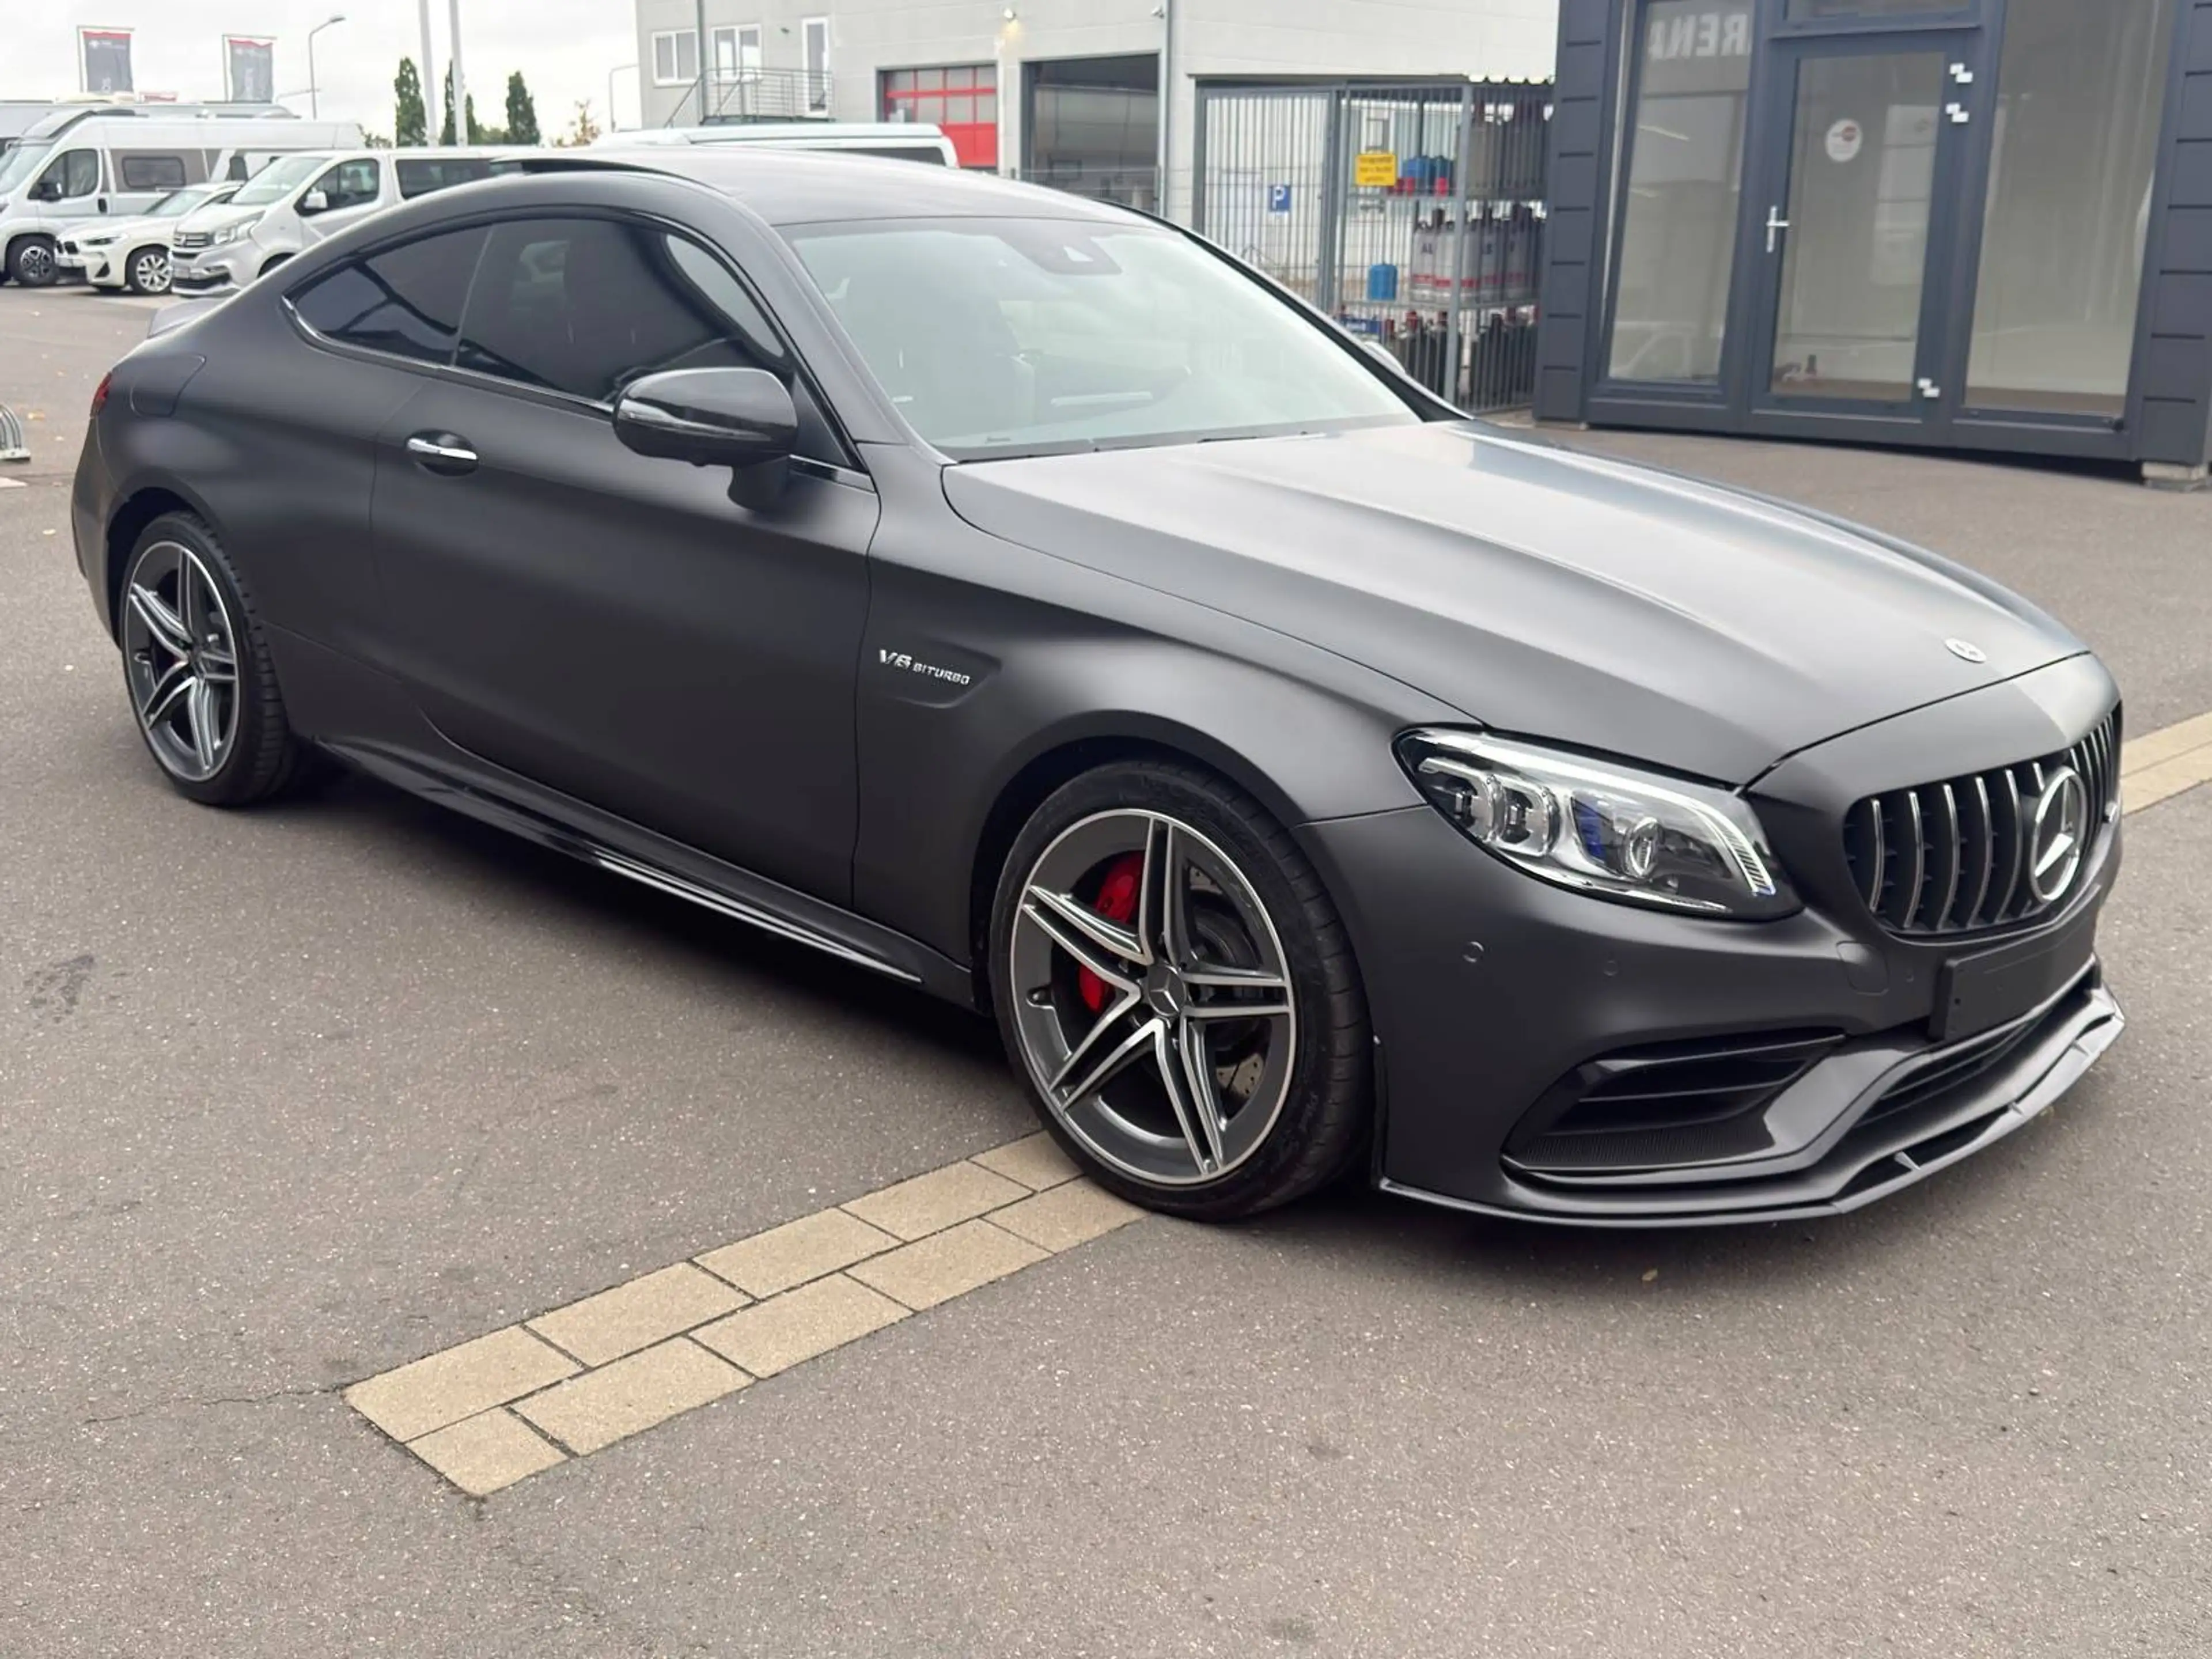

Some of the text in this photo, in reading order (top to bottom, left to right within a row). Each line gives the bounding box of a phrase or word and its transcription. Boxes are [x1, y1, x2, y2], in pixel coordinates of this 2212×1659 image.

[1272, 186, 1286, 210] P
[879, 649, 970, 685] V8 BITURBO
